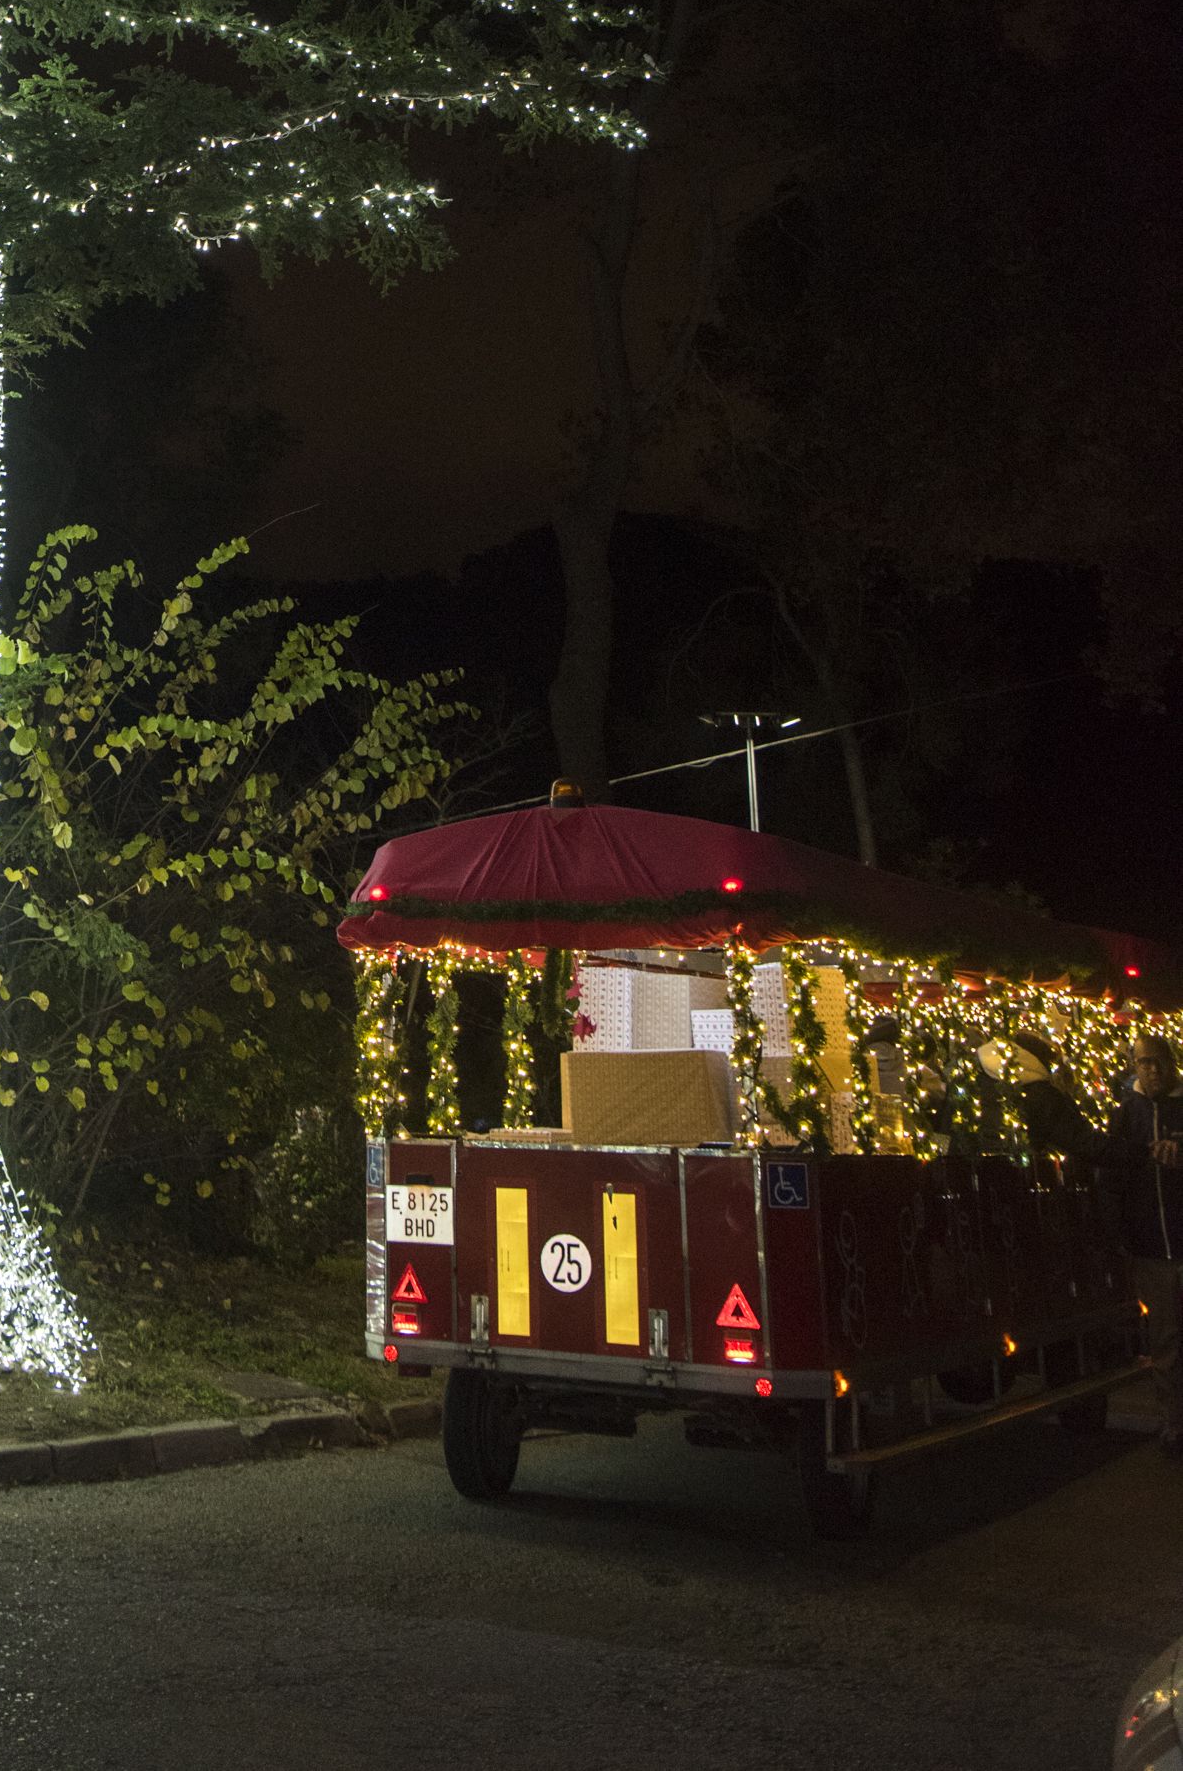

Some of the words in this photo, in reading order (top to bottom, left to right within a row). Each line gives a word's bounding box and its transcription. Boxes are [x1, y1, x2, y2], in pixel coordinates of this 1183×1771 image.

[391, 1191, 400, 1210] E
[407, 1192, 449, 1212] 8125
[404, 1217, 435, 1238] BHD
[550, 1241, 582, 1285] 25
